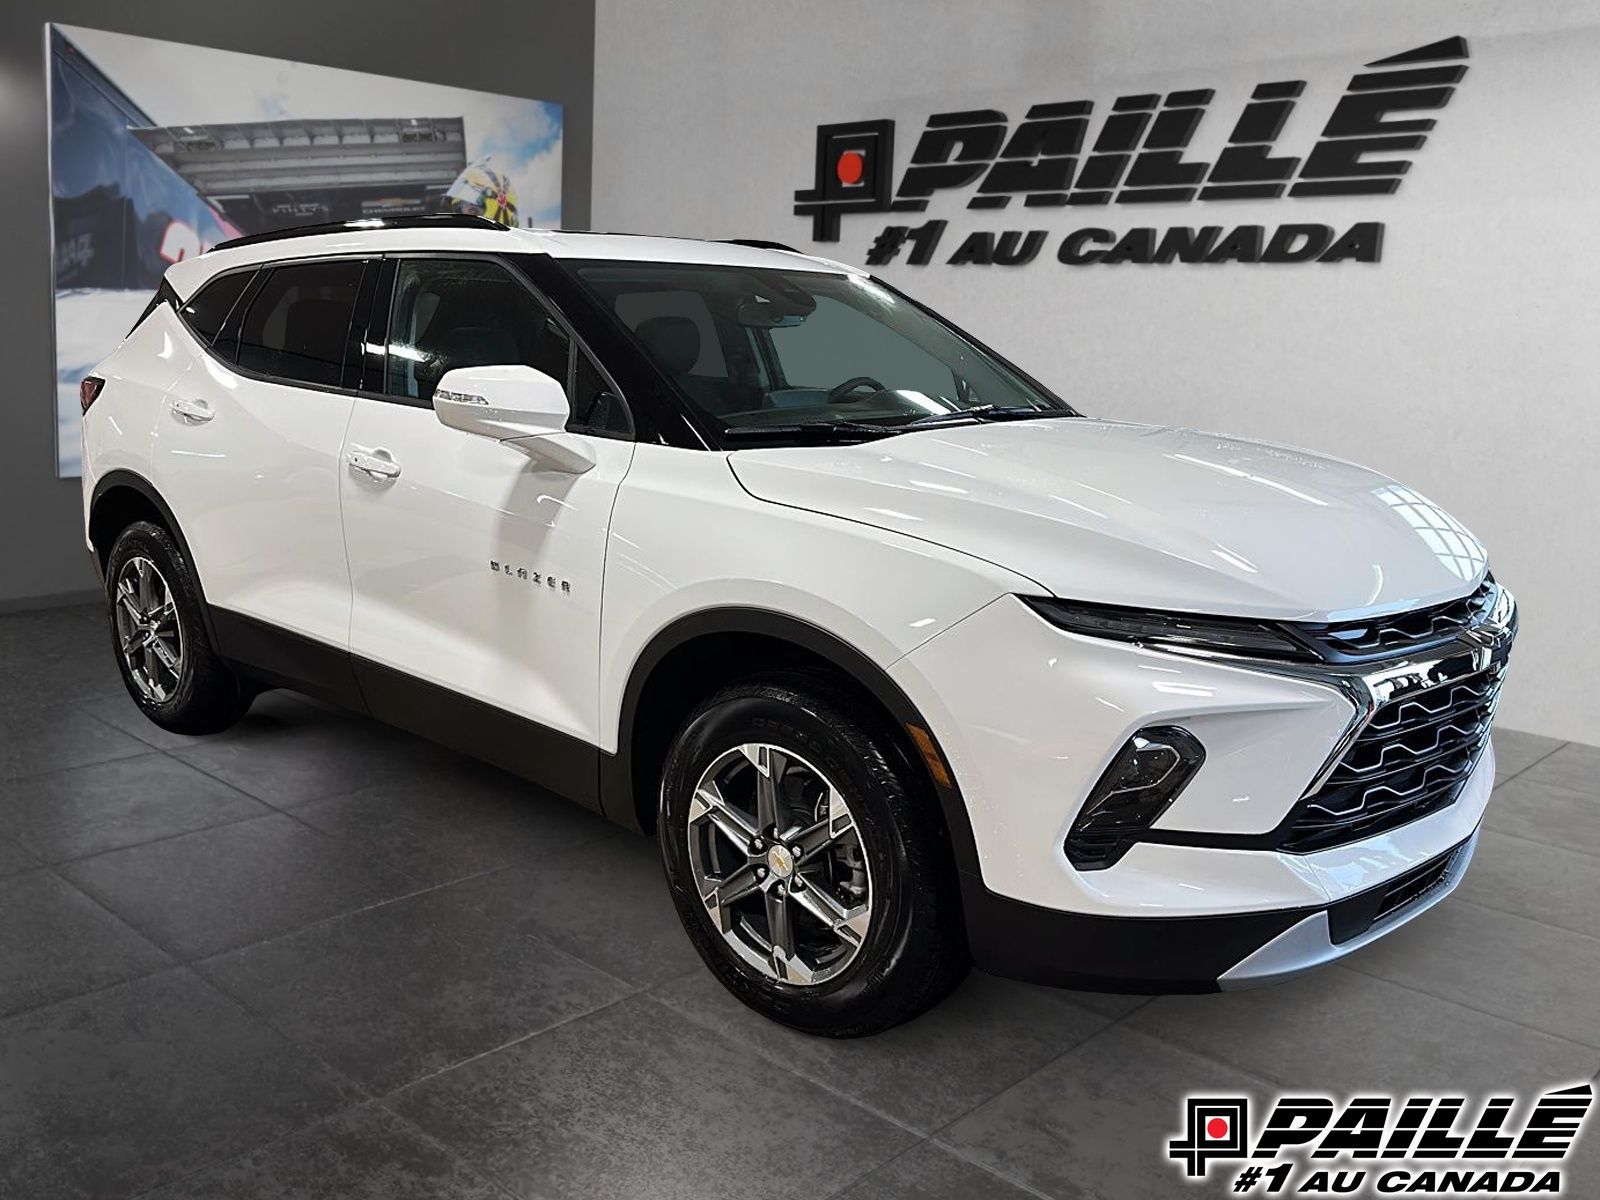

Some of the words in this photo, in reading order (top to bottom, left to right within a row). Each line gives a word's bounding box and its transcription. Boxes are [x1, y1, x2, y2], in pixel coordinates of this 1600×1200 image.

[892, 36, 1469, 211] PAILLÉ
[866, 219, 948, 266] #1
[946, 230, 1048, 266] AU
[1057, 222, 1385, 266] CANADA
[490, 560, 570, 593] BLAZER
